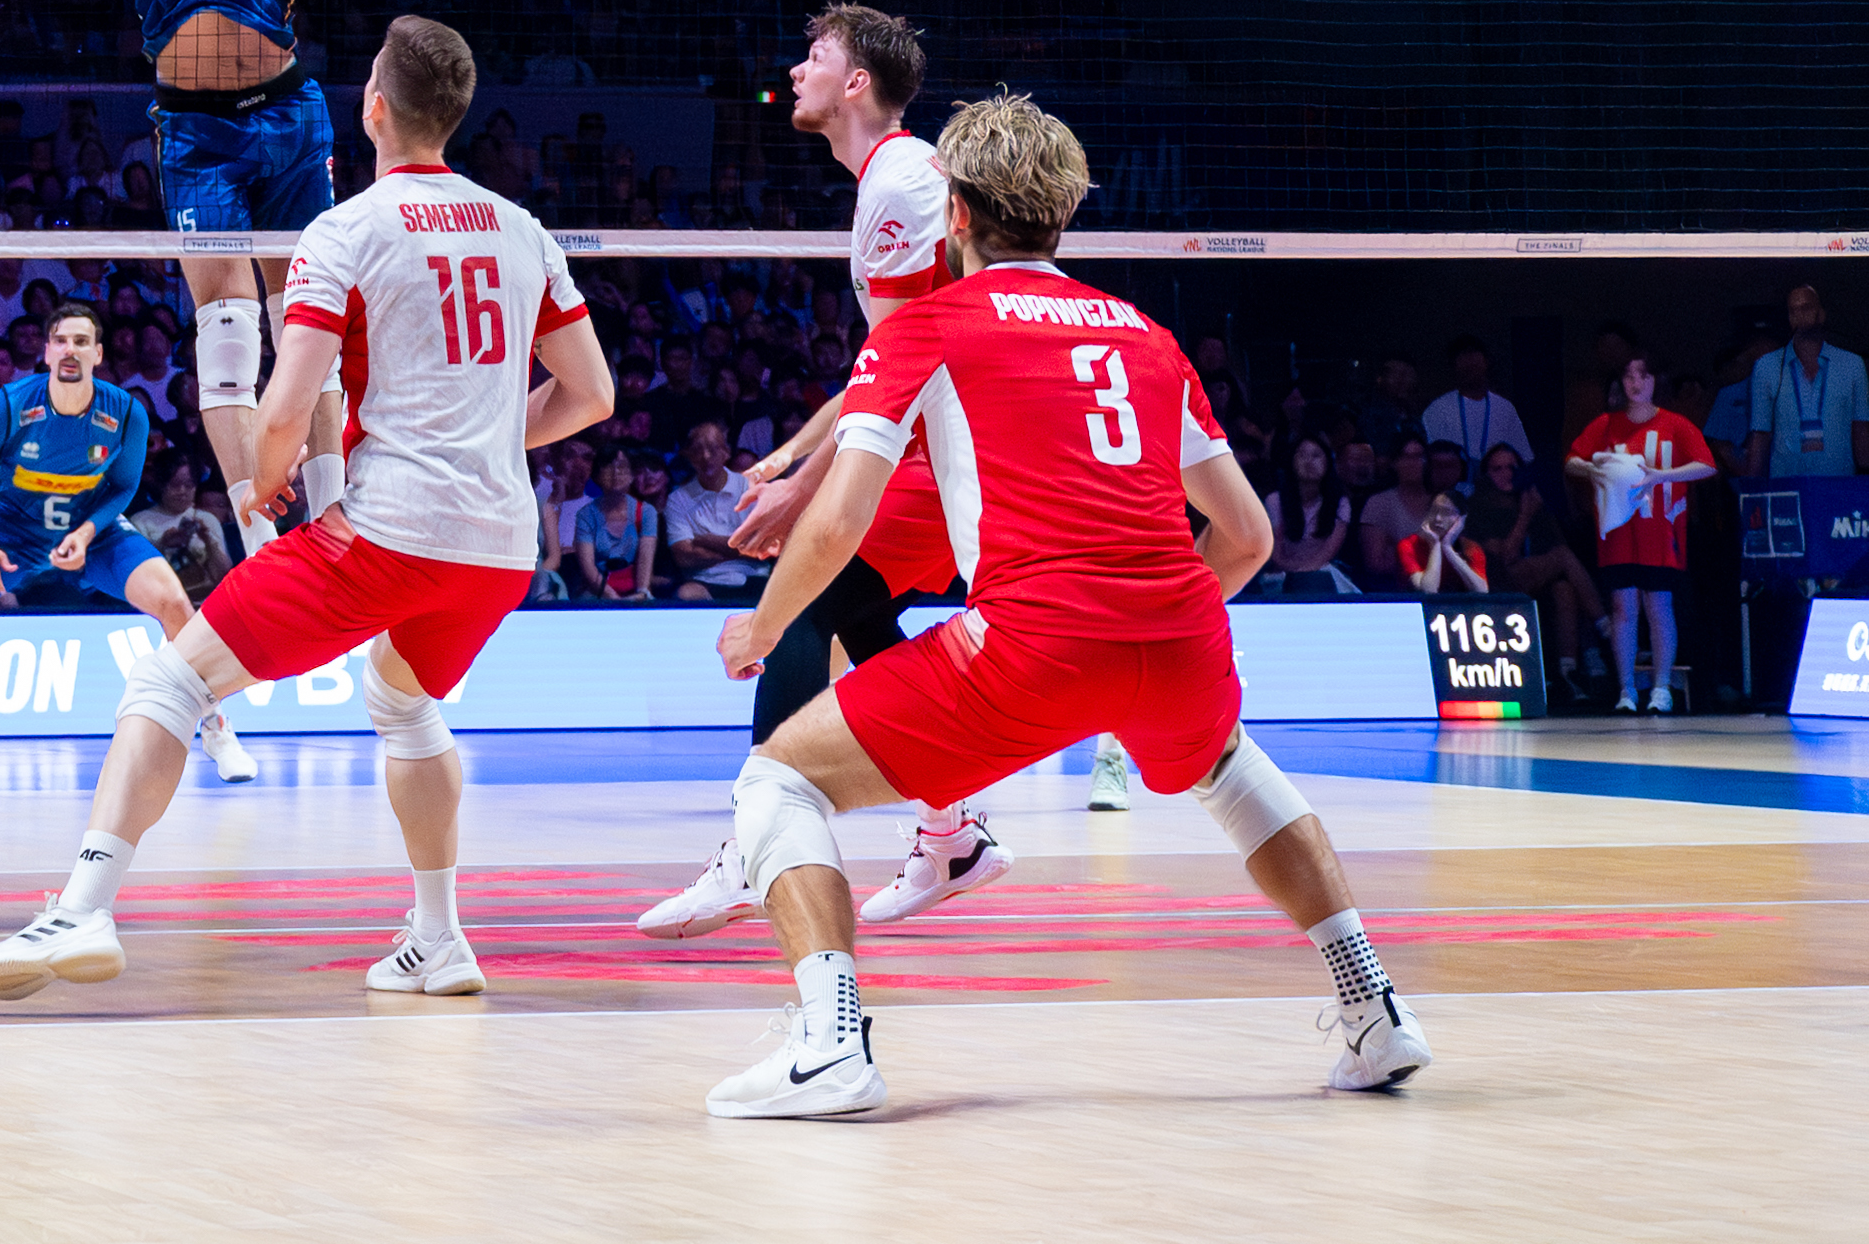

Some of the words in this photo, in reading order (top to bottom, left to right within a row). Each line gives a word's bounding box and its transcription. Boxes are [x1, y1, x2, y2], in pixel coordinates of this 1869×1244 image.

[177, 208, 197, 232] 15
[398, 202, 501, 232] SEMENIUK
[191, 241, 208, 249] THE
[212, 241, 245, 249] FINALS
[878, 241, 910, 254] ORLEN
[1206, 237, 1265, 246] VOLLEYBALL
[1524, 242, 1540, 250] THE
[1543, 242, 1574, 250] FINALS
[427, 257, 506, 365] 16
[989, 292, 1150, 333] POPIWCZAK
[1071, 344, 1142, 466] 3
[44, 495, 72, 530] 6
[1430, 614, 1530, 653] 116.3
[1448, 657, 1523, 687] km/h
